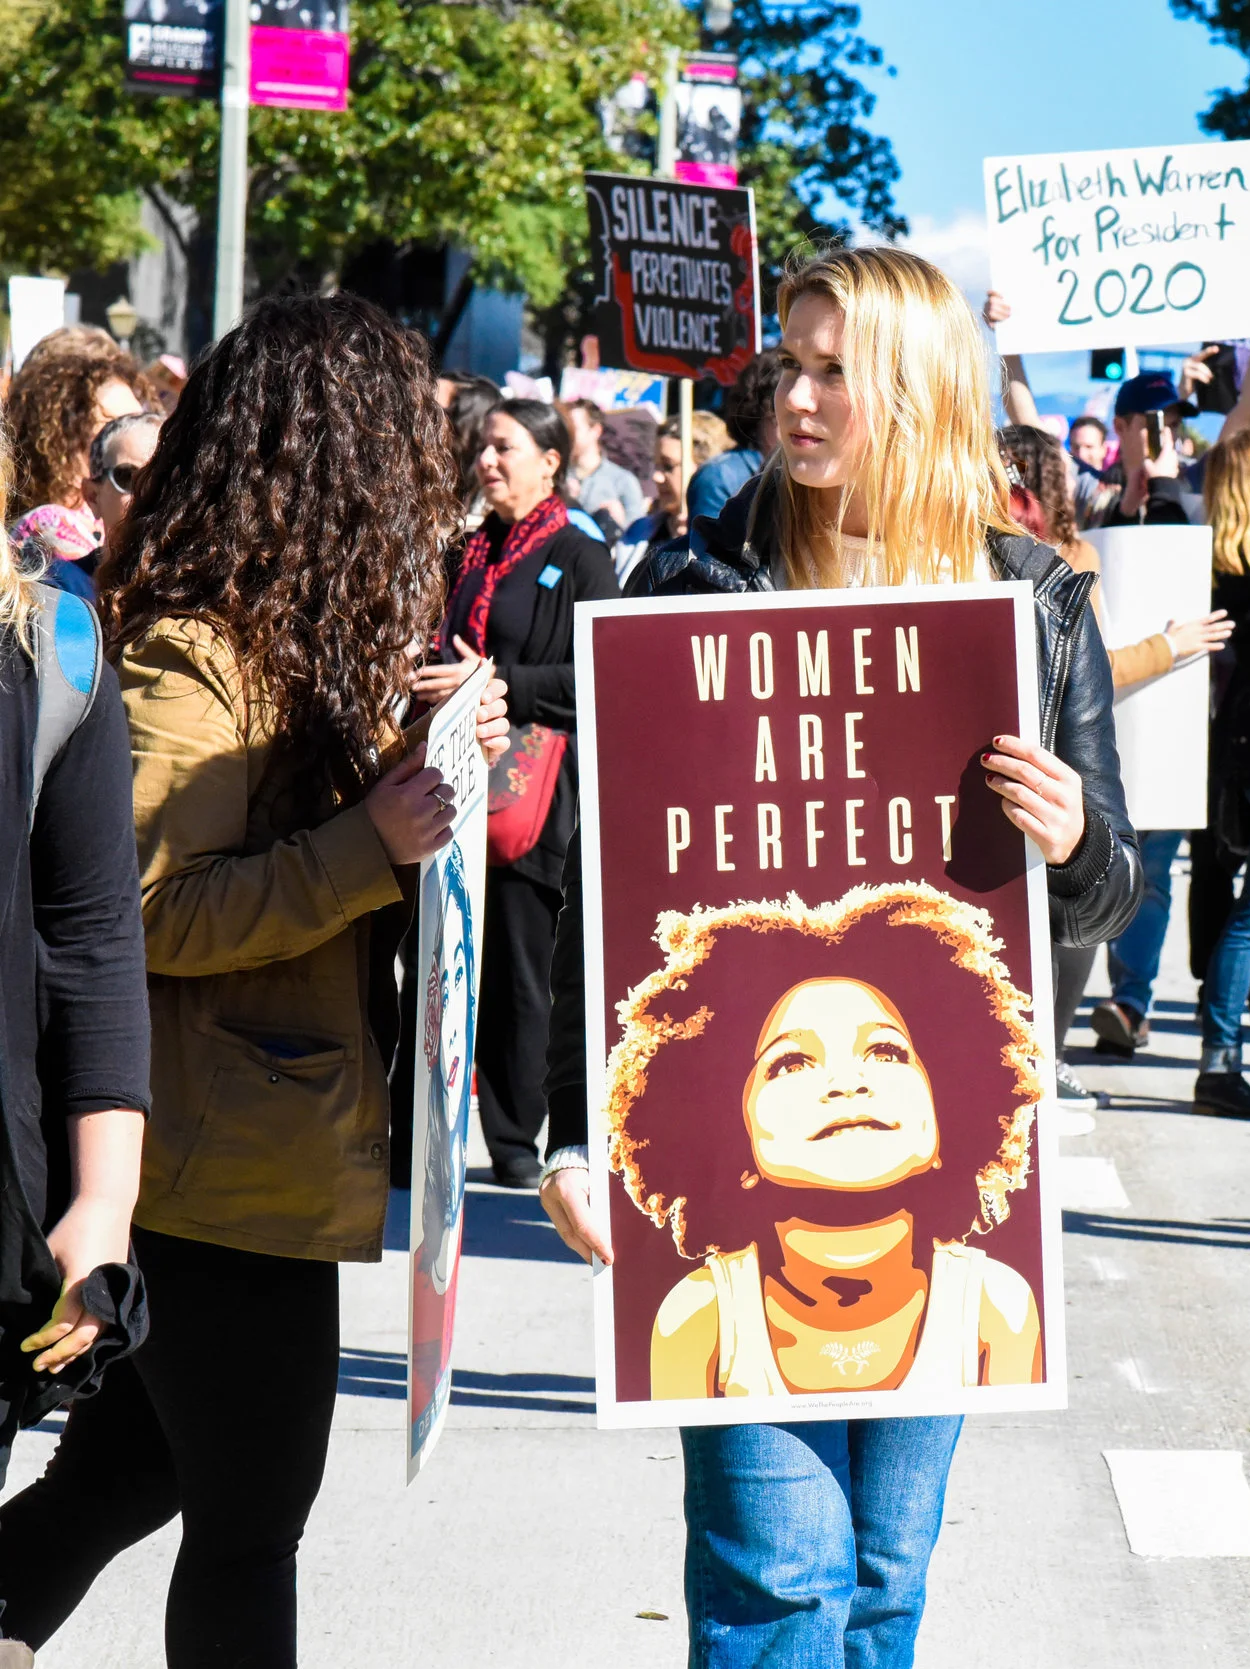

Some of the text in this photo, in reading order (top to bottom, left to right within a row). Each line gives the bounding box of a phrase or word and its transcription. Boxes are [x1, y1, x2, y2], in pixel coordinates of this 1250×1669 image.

[611, 185, 720, 249] SILENCE
[993, 155, 1249, 224] Elizabeth Warren
[1032, 202, 1235, 266] for President
[631, 250, 733, 305] PERPETUATES
[1057, 261, 1206, 325] 2020
[634, 302, 721, 354] VIOLENCE
[691, 626, 921, 701] WOMEN
[449, 705, 476, 769] THE
[755, 712, 866, 783] ARE
[452, 752, 476, 807] PLE
[667, 795, 956, 874] PERFECT
